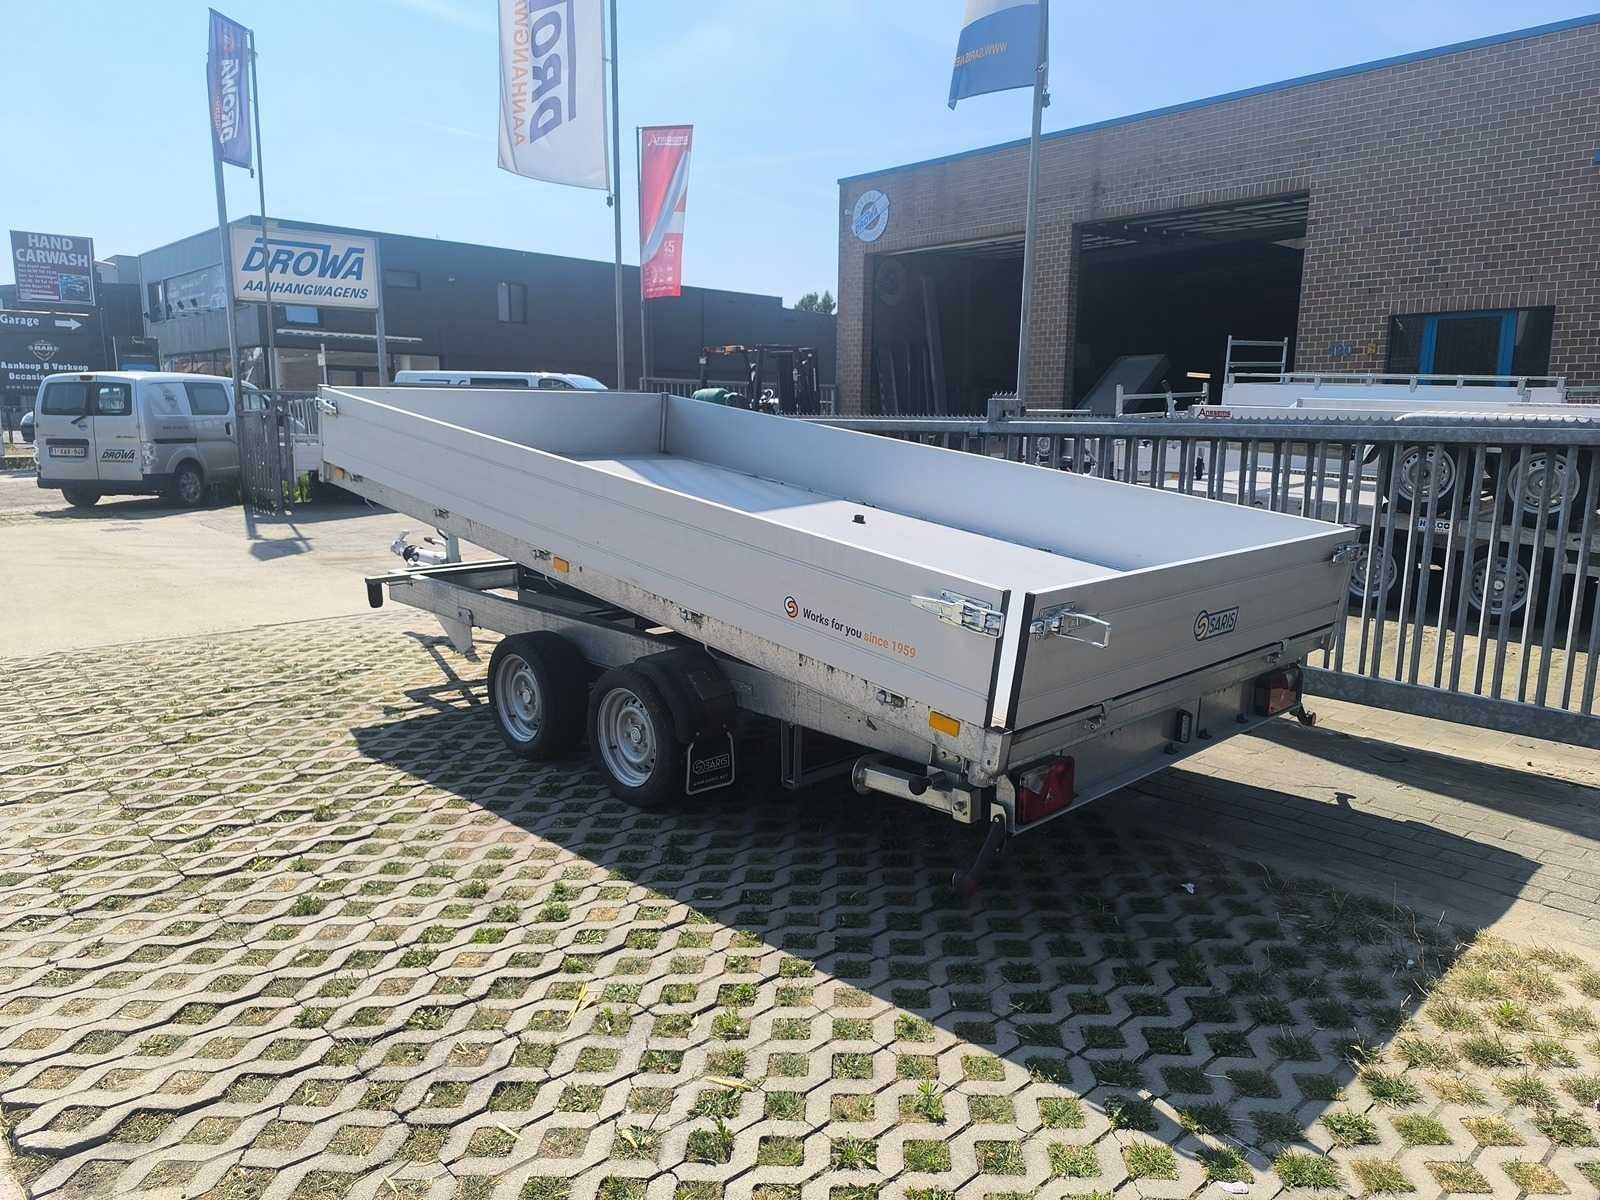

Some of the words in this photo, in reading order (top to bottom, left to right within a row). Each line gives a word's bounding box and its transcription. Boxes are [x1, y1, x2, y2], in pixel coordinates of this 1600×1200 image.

[28, 234, 73, 251] HAND
[15, 248, 89, 268] CARWASH
[241, 237, 365, 280] DROWA
[0, 313, 40, 327] Garage
[1, 361, 41, 371] Aankoop
[52, 363, 89, 372] Verkoop
[101, 448, 136, 460] DROWA
[1209, 611, 1236, 633] SARIS
[803, 607, 829, 627] Works
[830, 618, 844, 632] for
[845, 625, 862, 639] you
[863, 631, 889, 649] since
[892, 640, 916, 658] 1959
